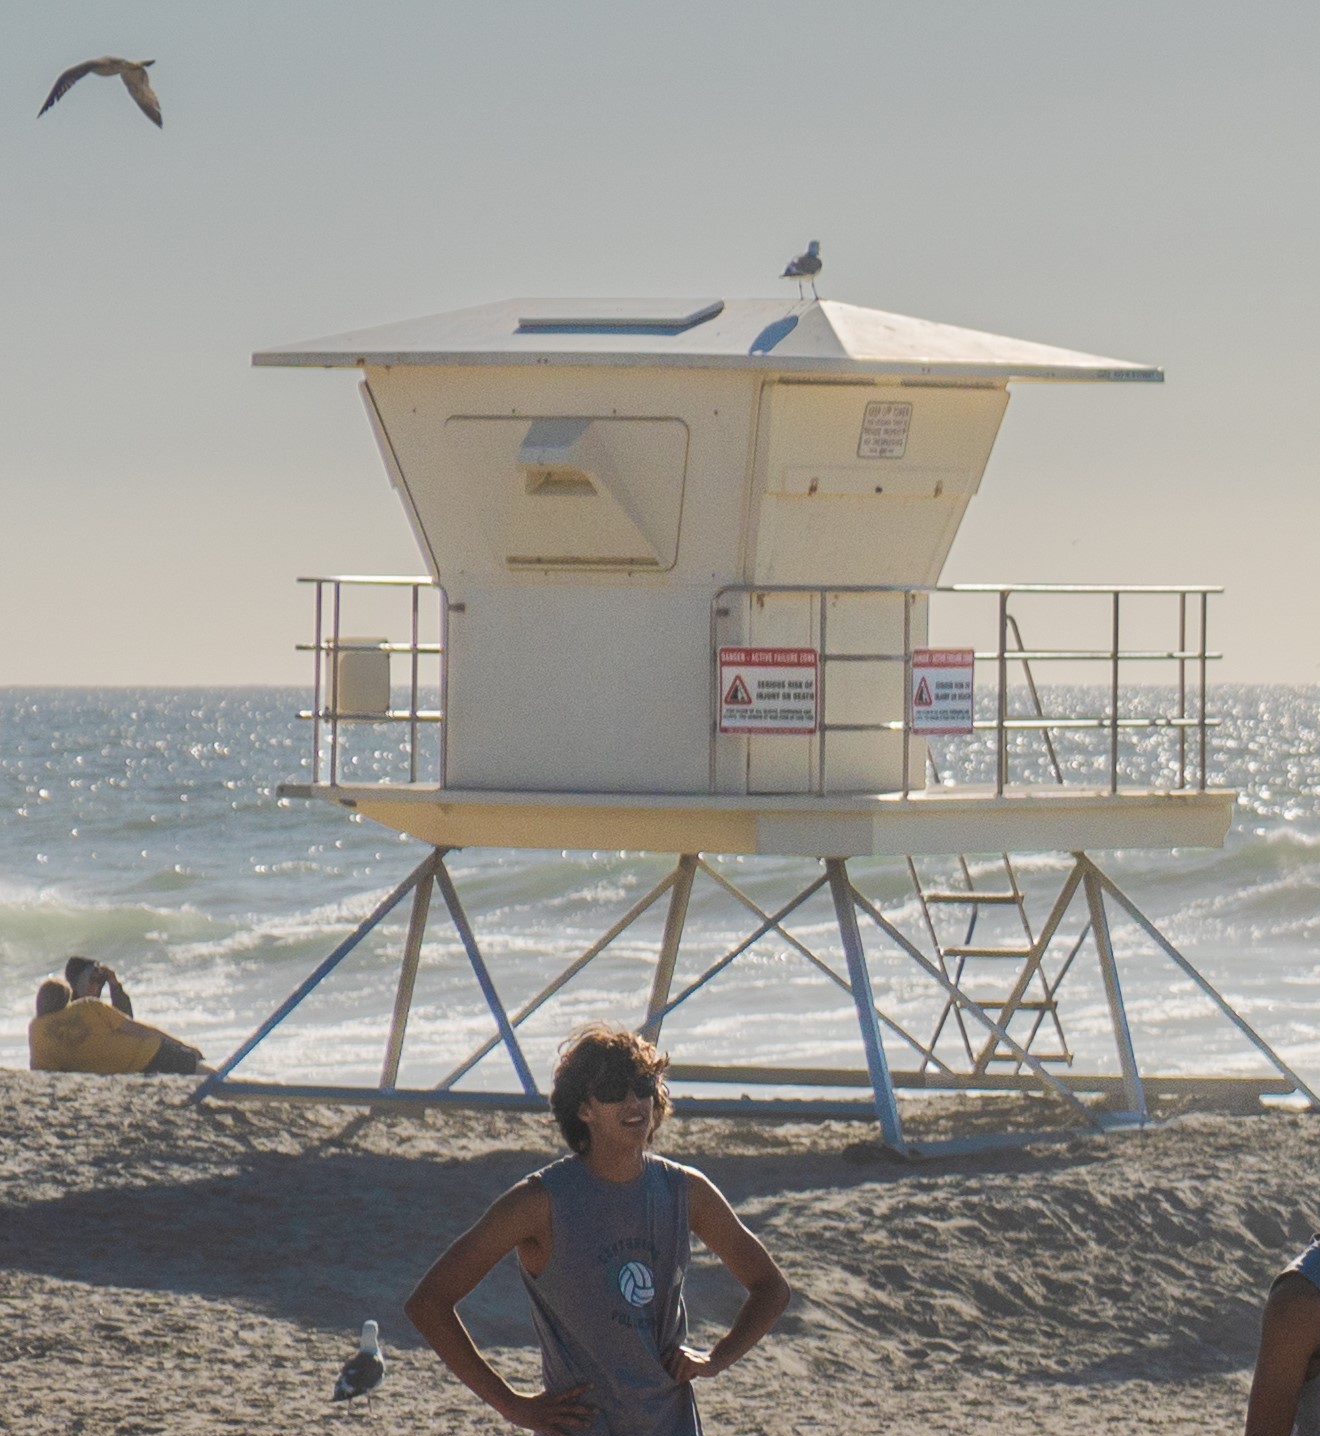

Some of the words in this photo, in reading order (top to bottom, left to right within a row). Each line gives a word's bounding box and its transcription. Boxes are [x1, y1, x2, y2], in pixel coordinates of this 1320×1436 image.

[721, 651, 745, 663] DANGER
[751, 652, 773, 663] ACTIVE
[757, 680, 786, 689] SERIOUS
[787, 680, 803, 689] RISK
[804, 680, 813, 689] OF
[756, 692, 780, 701] INJURY
[782, 692, 791, 700] OR
[793, 692, 814, 701] DEATH
